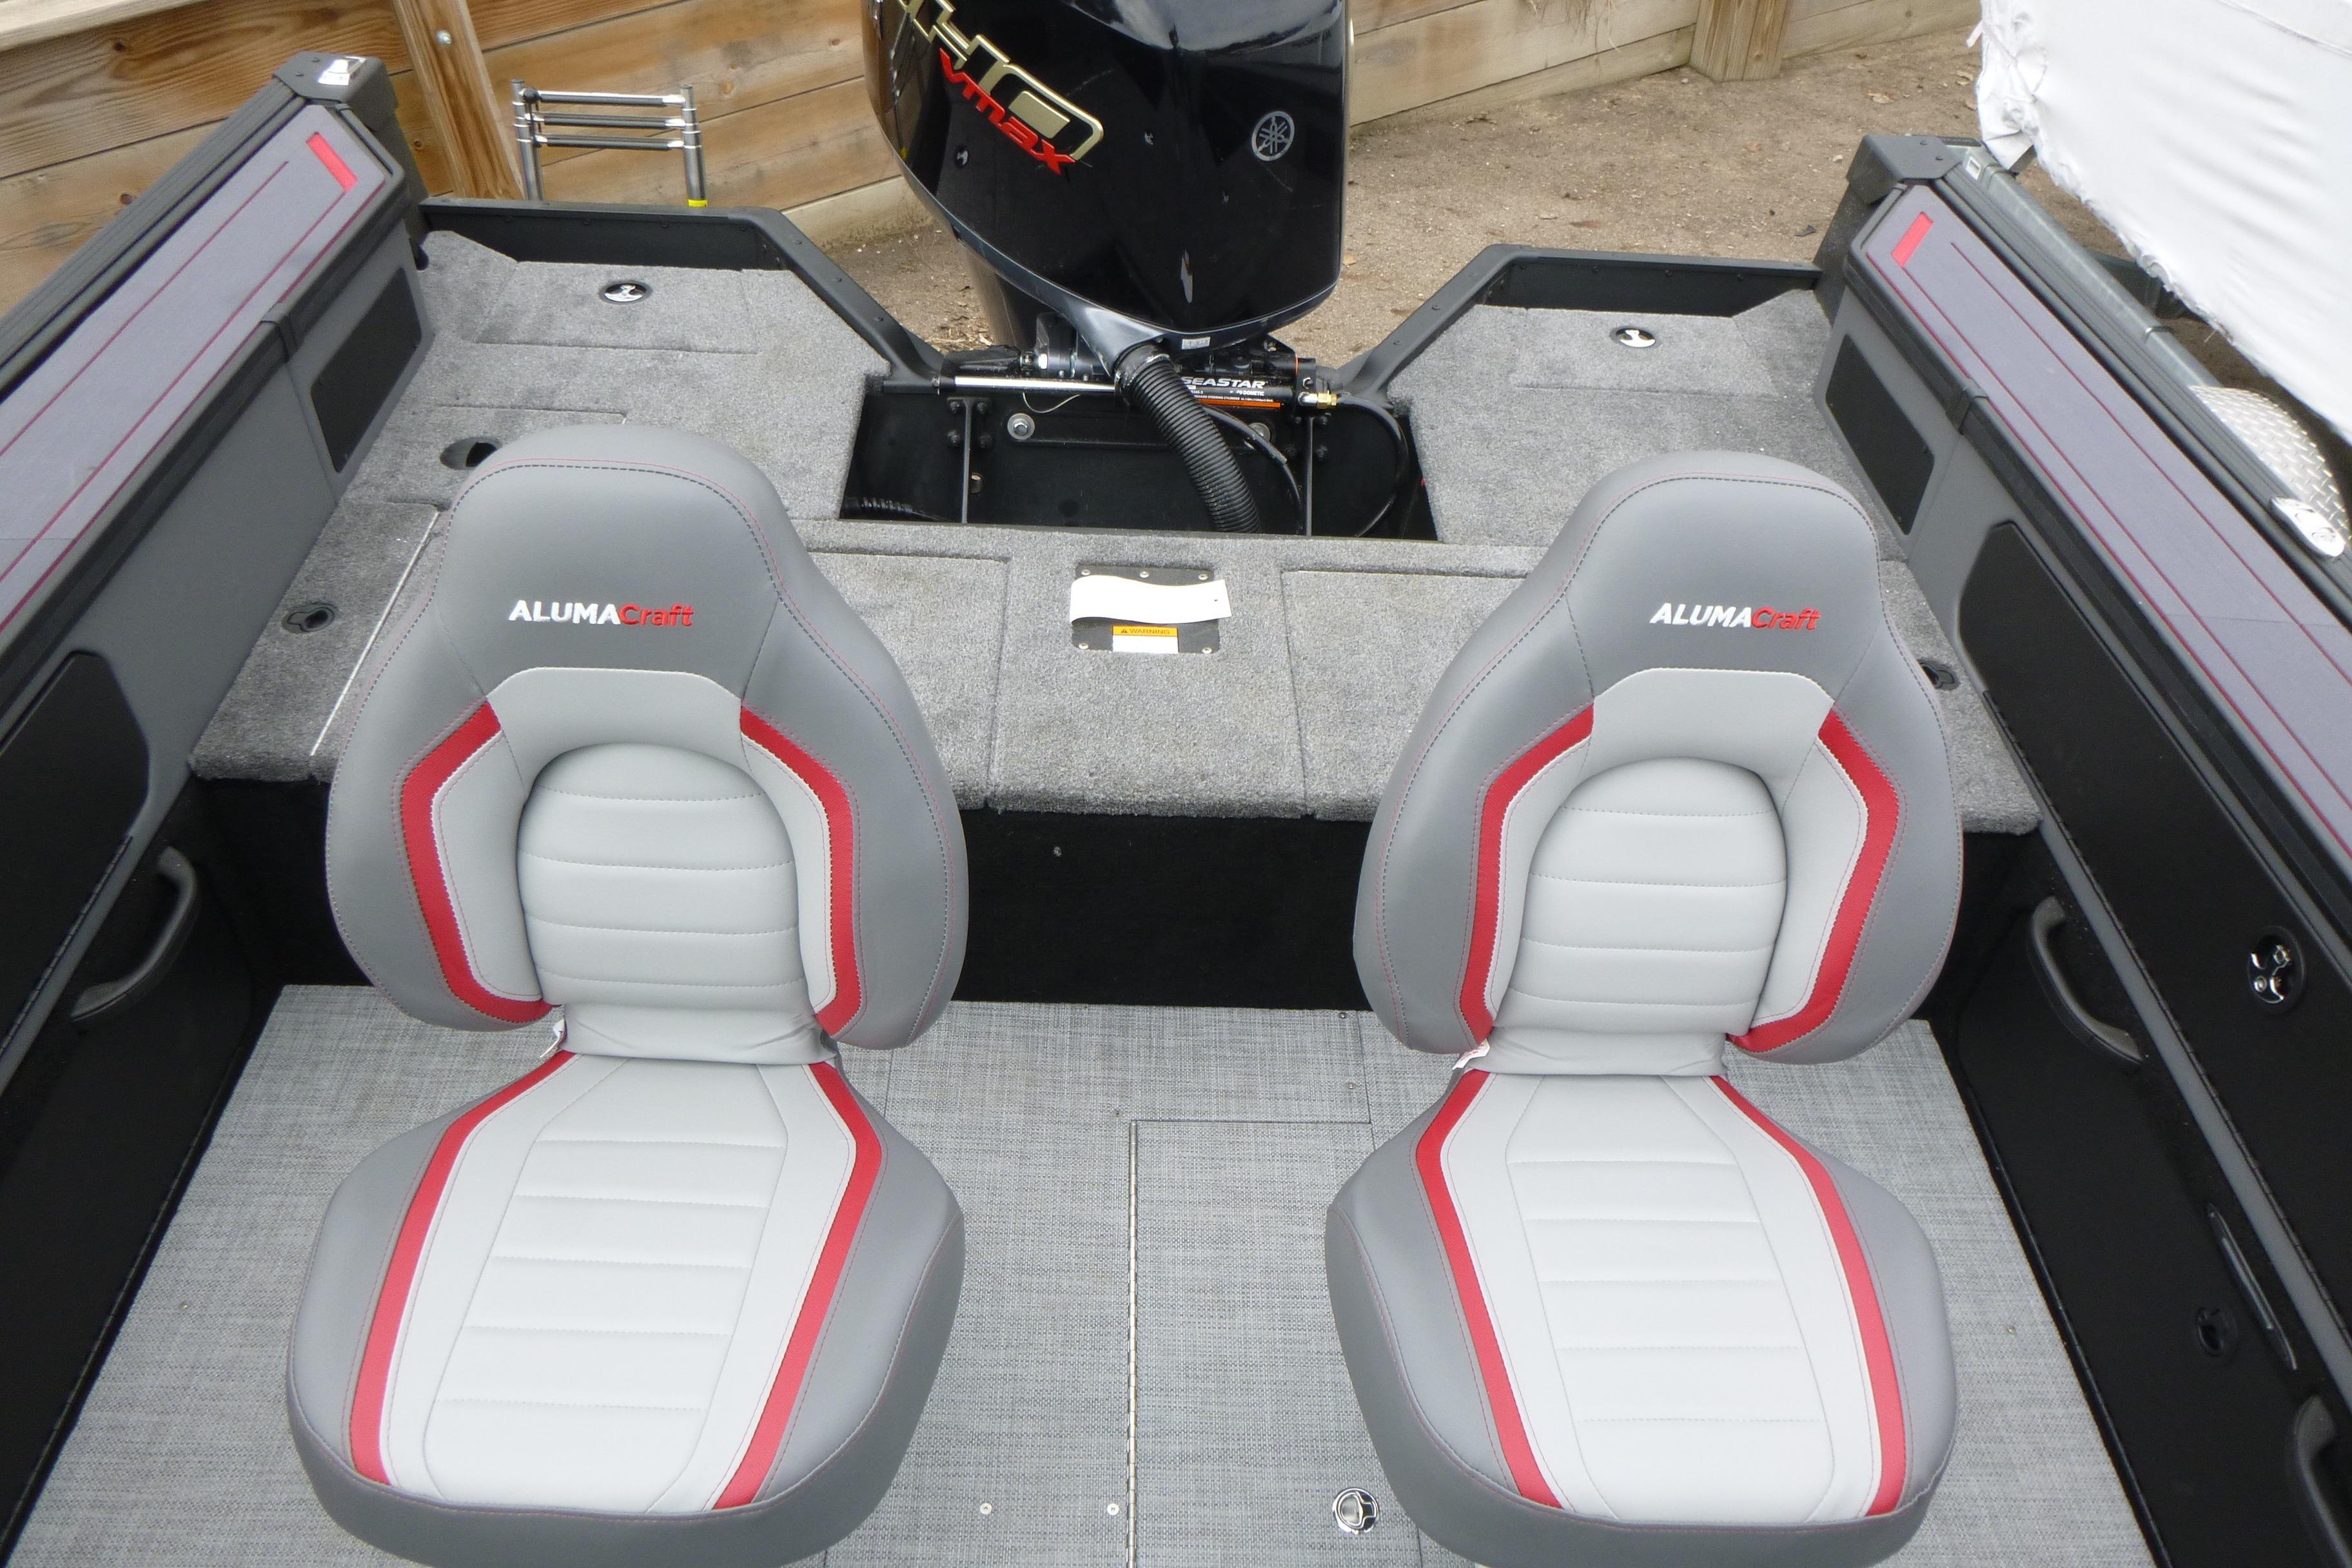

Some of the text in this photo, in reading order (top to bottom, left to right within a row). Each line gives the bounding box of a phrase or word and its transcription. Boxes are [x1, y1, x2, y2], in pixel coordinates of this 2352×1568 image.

[1181, 377, 1266, 389] SEASTAR
[508, 600, 694, 627] ALUMACraft
[1649, 602, 1821, 631] ALUMACraft
